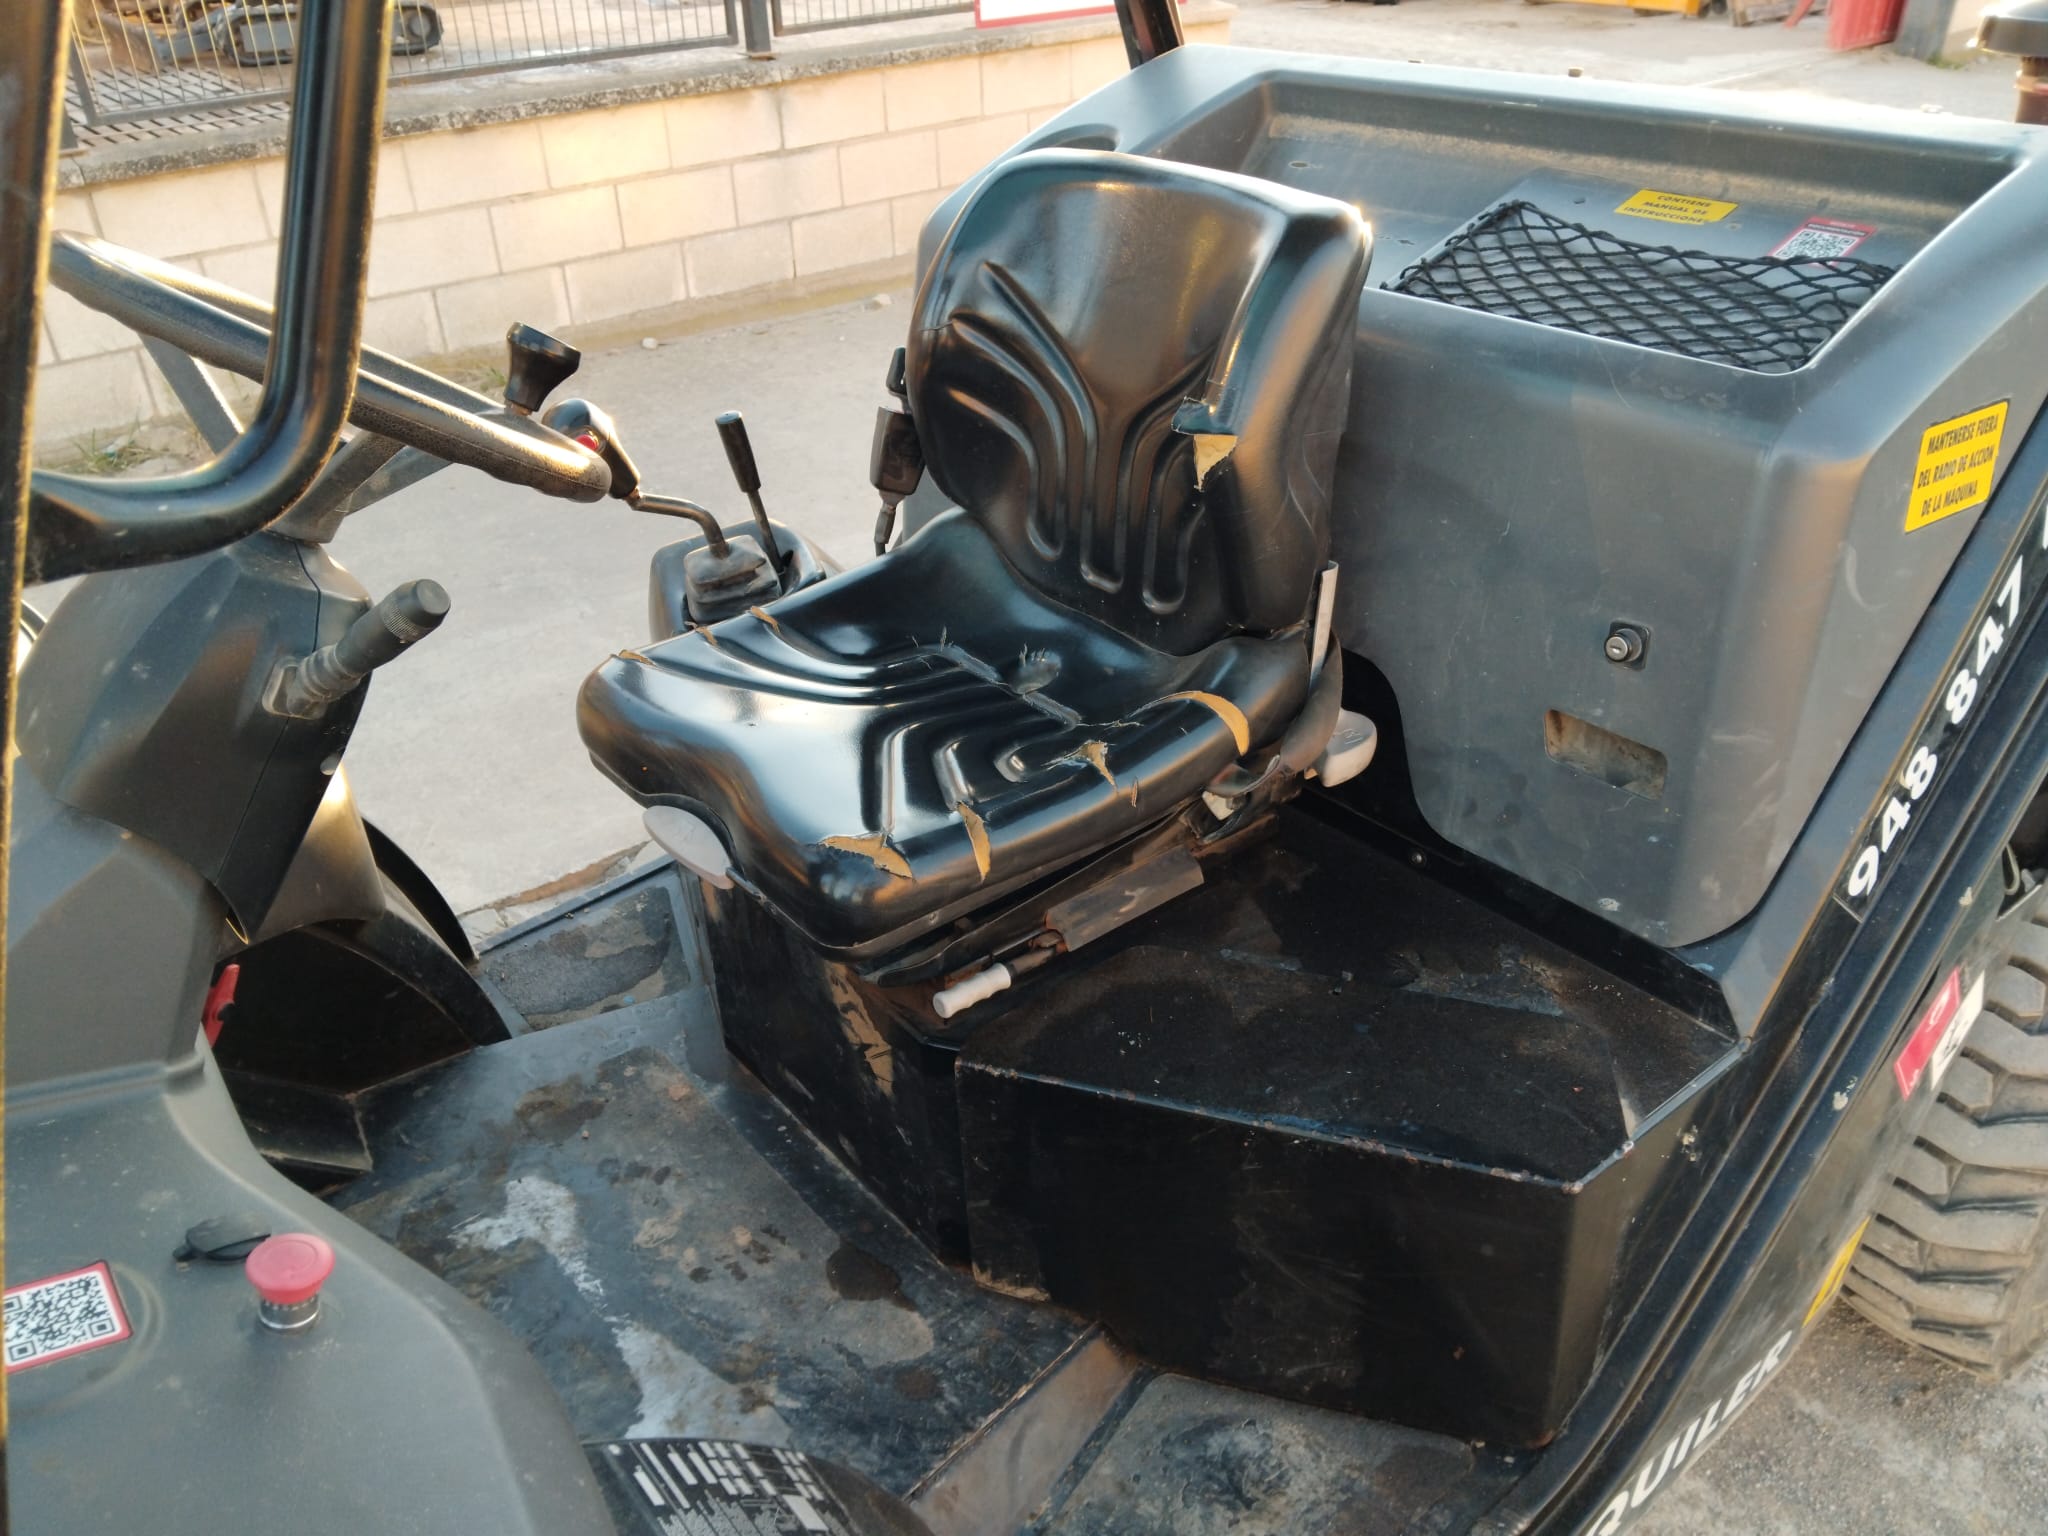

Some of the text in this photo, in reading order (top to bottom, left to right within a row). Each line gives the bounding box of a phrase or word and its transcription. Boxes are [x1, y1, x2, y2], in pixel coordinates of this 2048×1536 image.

[1643, 201, 1690, 213] MANUAL
[1927, 414, 1999, 454] MANTENERSE FUERA
[1918, 468, 1932, 489] DEL
[1933, 459, 1957, 483] RADIO
[1957, 454, 1969, 474] DE
[1921, 497, 1932, 517] DE
[1933, 494, 1942, 513] LA
[1848, 555, 2022, 897] 948 847
